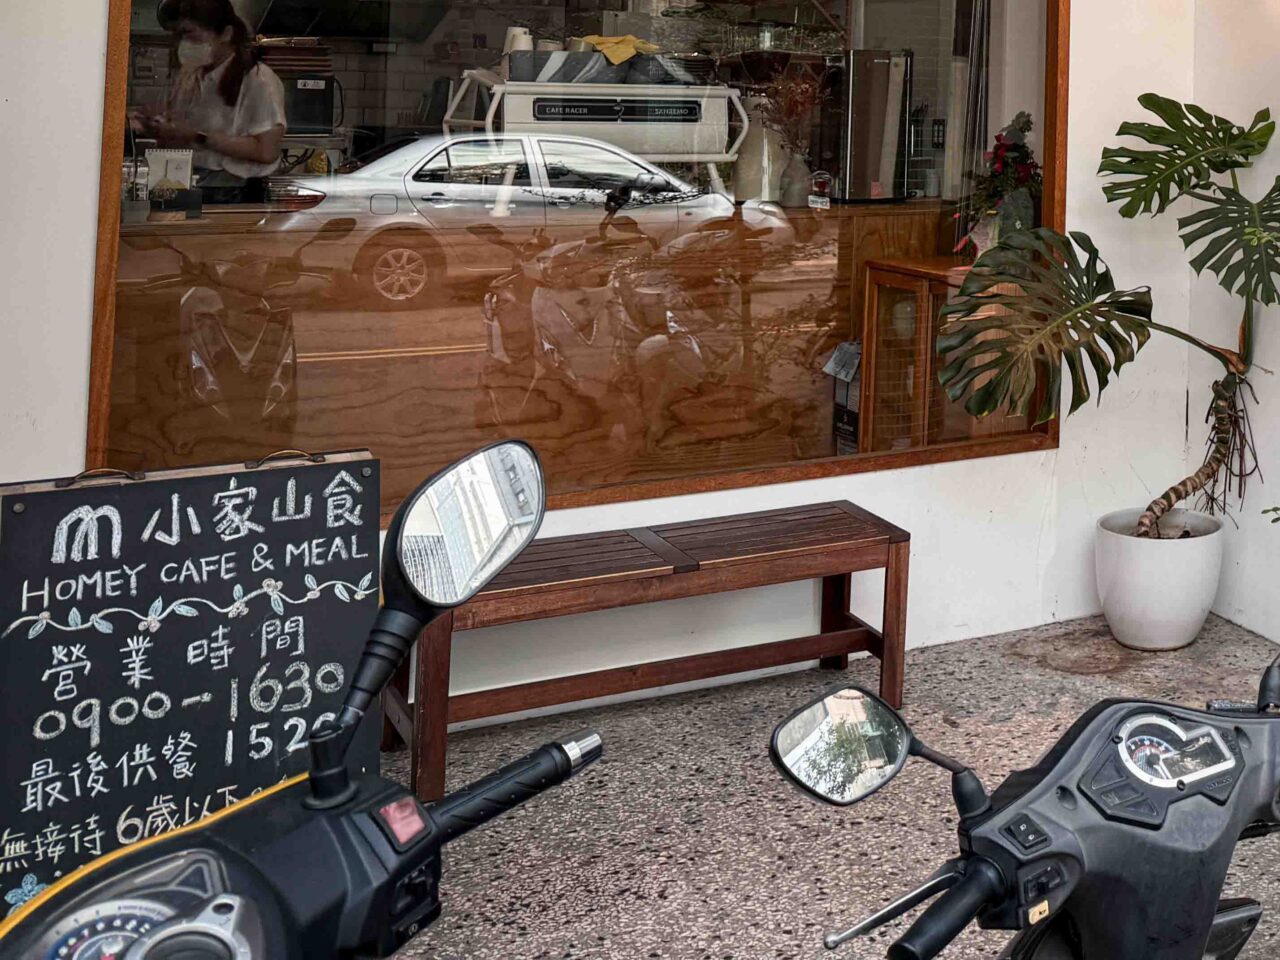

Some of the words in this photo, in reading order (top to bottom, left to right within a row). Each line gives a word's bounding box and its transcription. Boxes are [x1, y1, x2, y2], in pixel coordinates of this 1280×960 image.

[140, 469, 364, 546] 小家山食
[21, 562, 147, 612] HOMEY
[160, 552, 238, 584] CAFE
[252, 542, 275, 572] &
[285, 535, 369, 567] MEAL
[41, 615, 305, 702] 營業時間
[20, 730, 198, 813] 最後供餐
